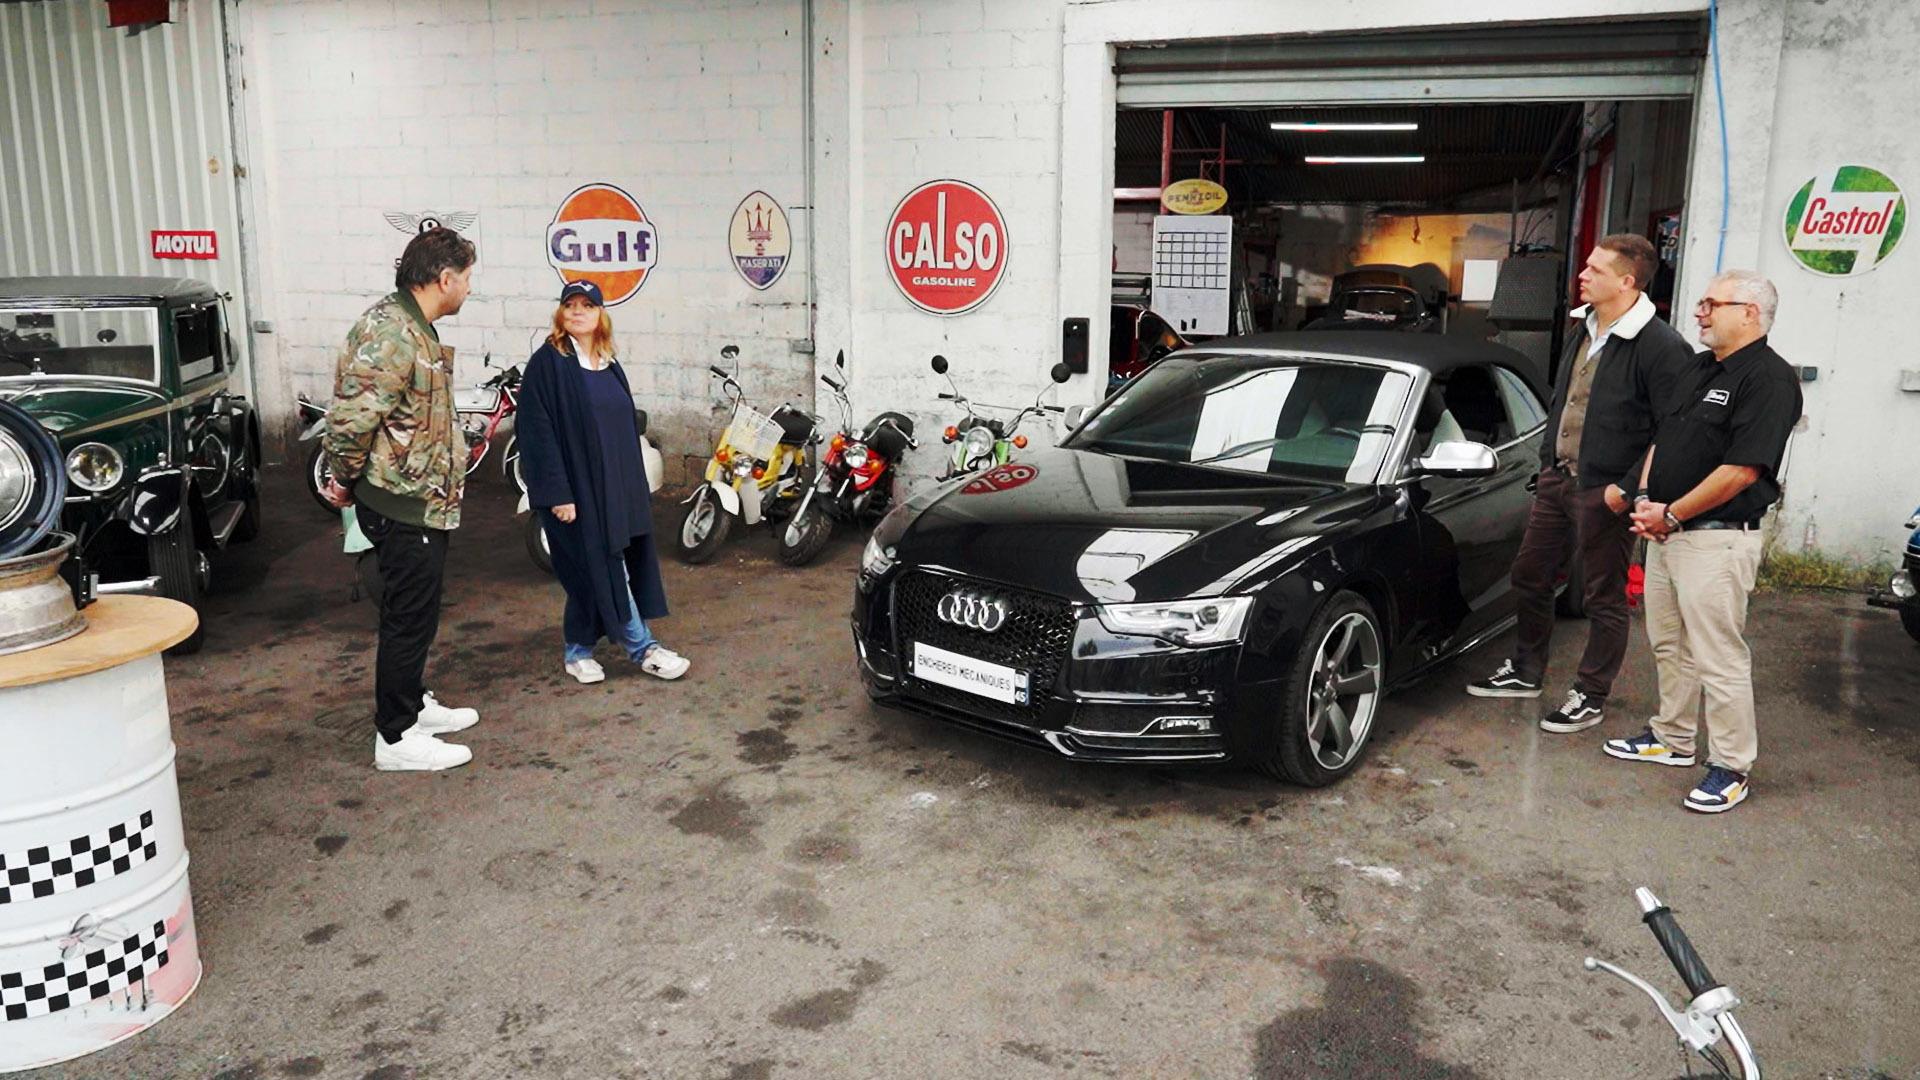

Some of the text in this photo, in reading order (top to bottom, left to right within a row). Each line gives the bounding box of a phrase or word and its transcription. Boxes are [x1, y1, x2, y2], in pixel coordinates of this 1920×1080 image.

[894, 191, 998, 271] CALSO
[1803, 197, 1894, 234] Castrol
[155, 235, 215, 253] MOTUL
[551, 228, 651, 262] Gulf
[912, 276, 976, 287] GASOLINE
[918, 654, 1011, 691] ENCHERES MECANIQUES
[1014, 690, 1027, 703] 45
